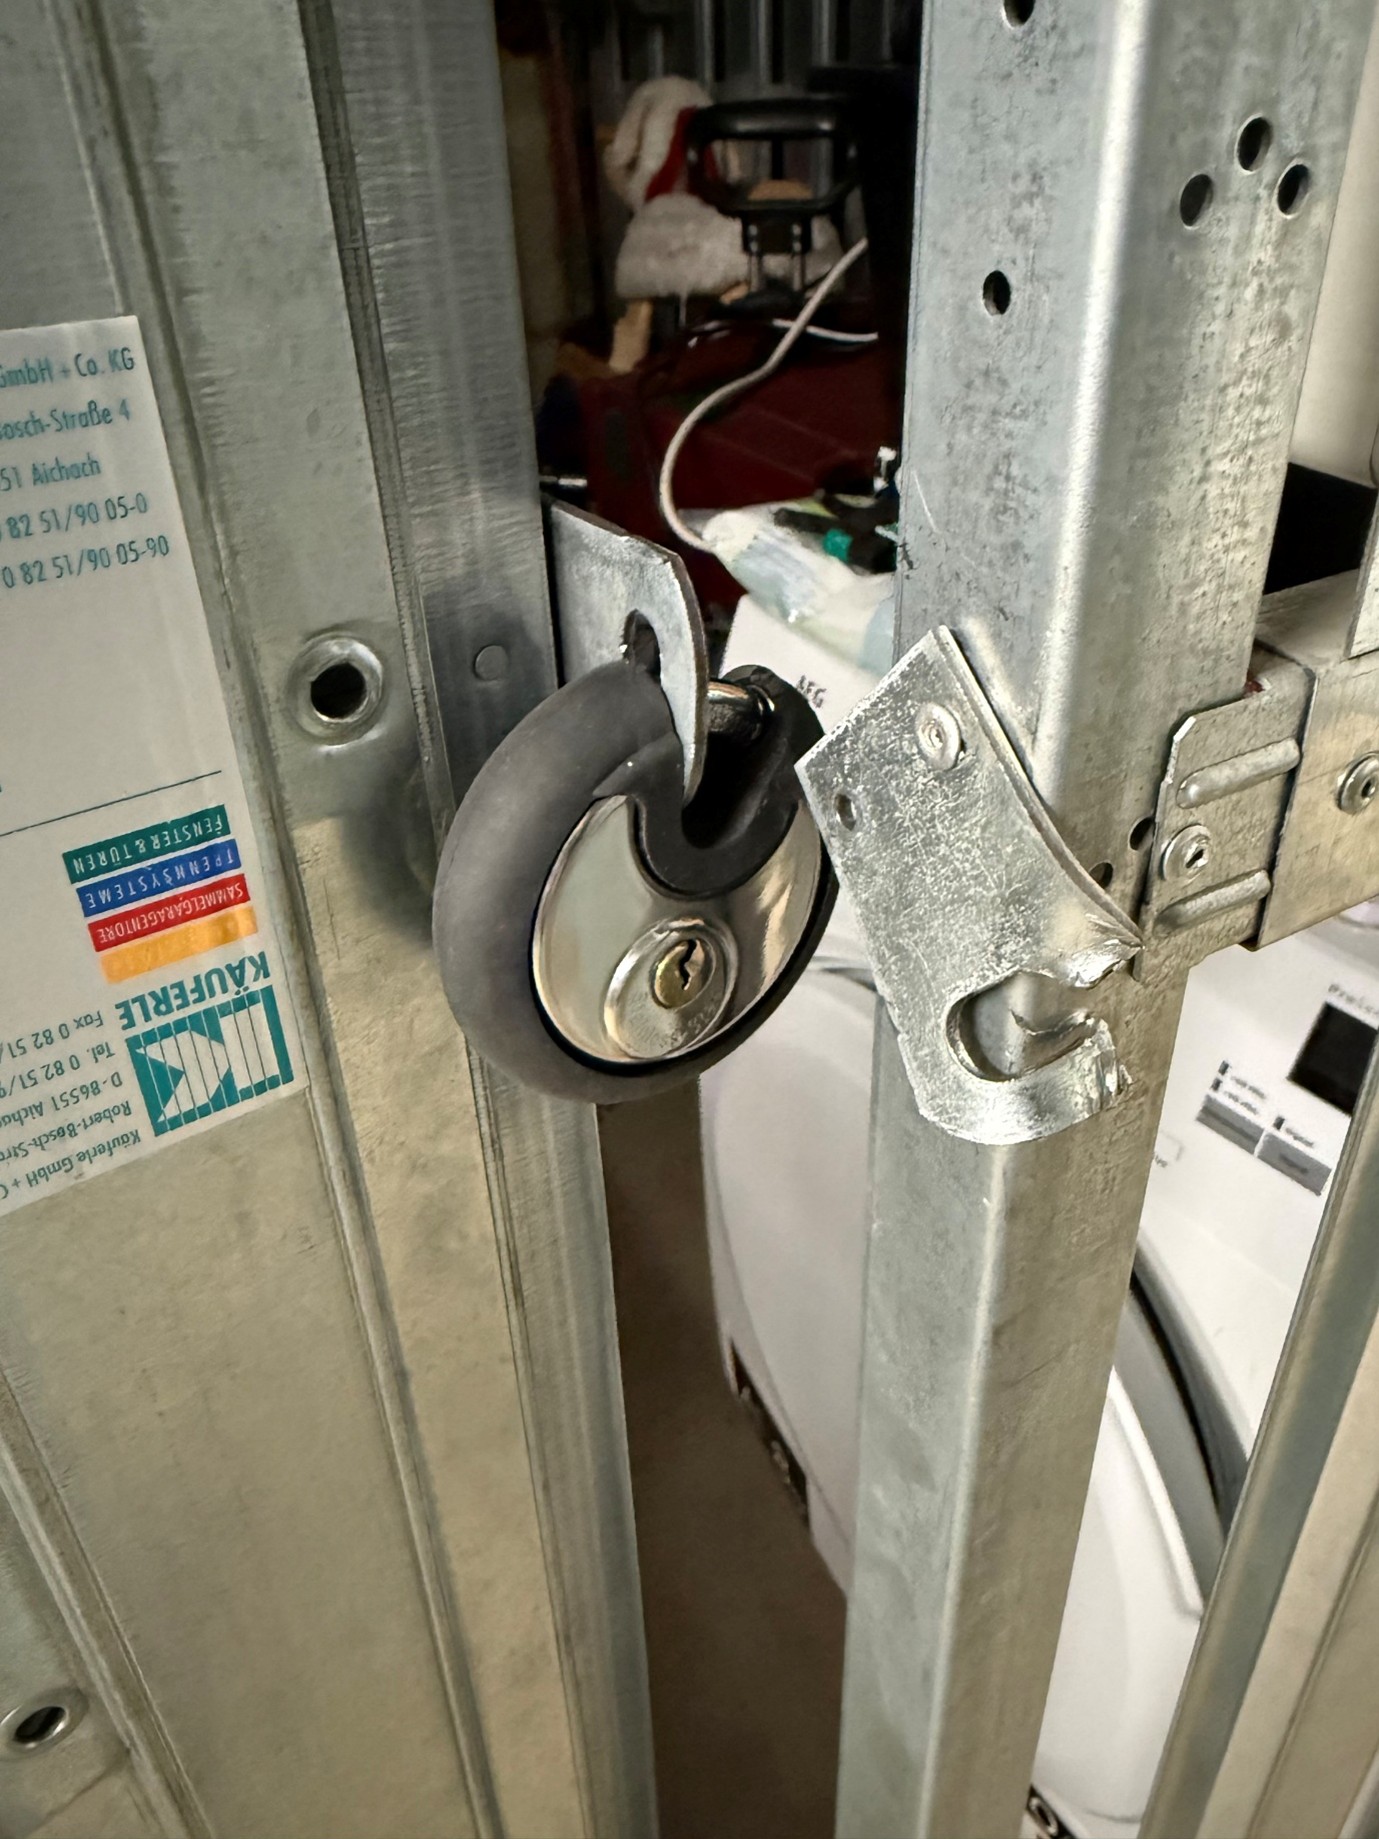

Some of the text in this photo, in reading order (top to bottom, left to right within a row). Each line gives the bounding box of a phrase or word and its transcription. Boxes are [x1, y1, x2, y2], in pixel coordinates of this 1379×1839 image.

[74, 352, 105, 377] Co.
[108, 346, 134, 372] KG
[0, 398, 130, 441] osch-Straße 4
[0, 452, 101, 491] 51 Aichach
[6, 492, 148, 538] 82 51/90 05-0
[2, 535, 169, 588] 0 82 51/90 05-90
[73, 813, 224, 875] FENSTER & TÜREN
[85, 849, 235, 909] TRENNSYSTEME
[97, 882, 244, 944] SAMMELGARAGENTORE
[115, 951, 271, 1031] KÄUFERLE
[58, 1023, 70, 1040] 0
[73, 1011, 104, 1029] Fax
[32, 1029, 54, 1050] 82
[86, 1042, 115, 1063] Tel.
[40, 1060, 65, 1081] 82
[69, 1054, 81, 1070] 0
[76, 1129, 141, 1164] Käuferle
[11, 1178, 22, 1189] +
[25, 1154, 74, 1188] GmbH
